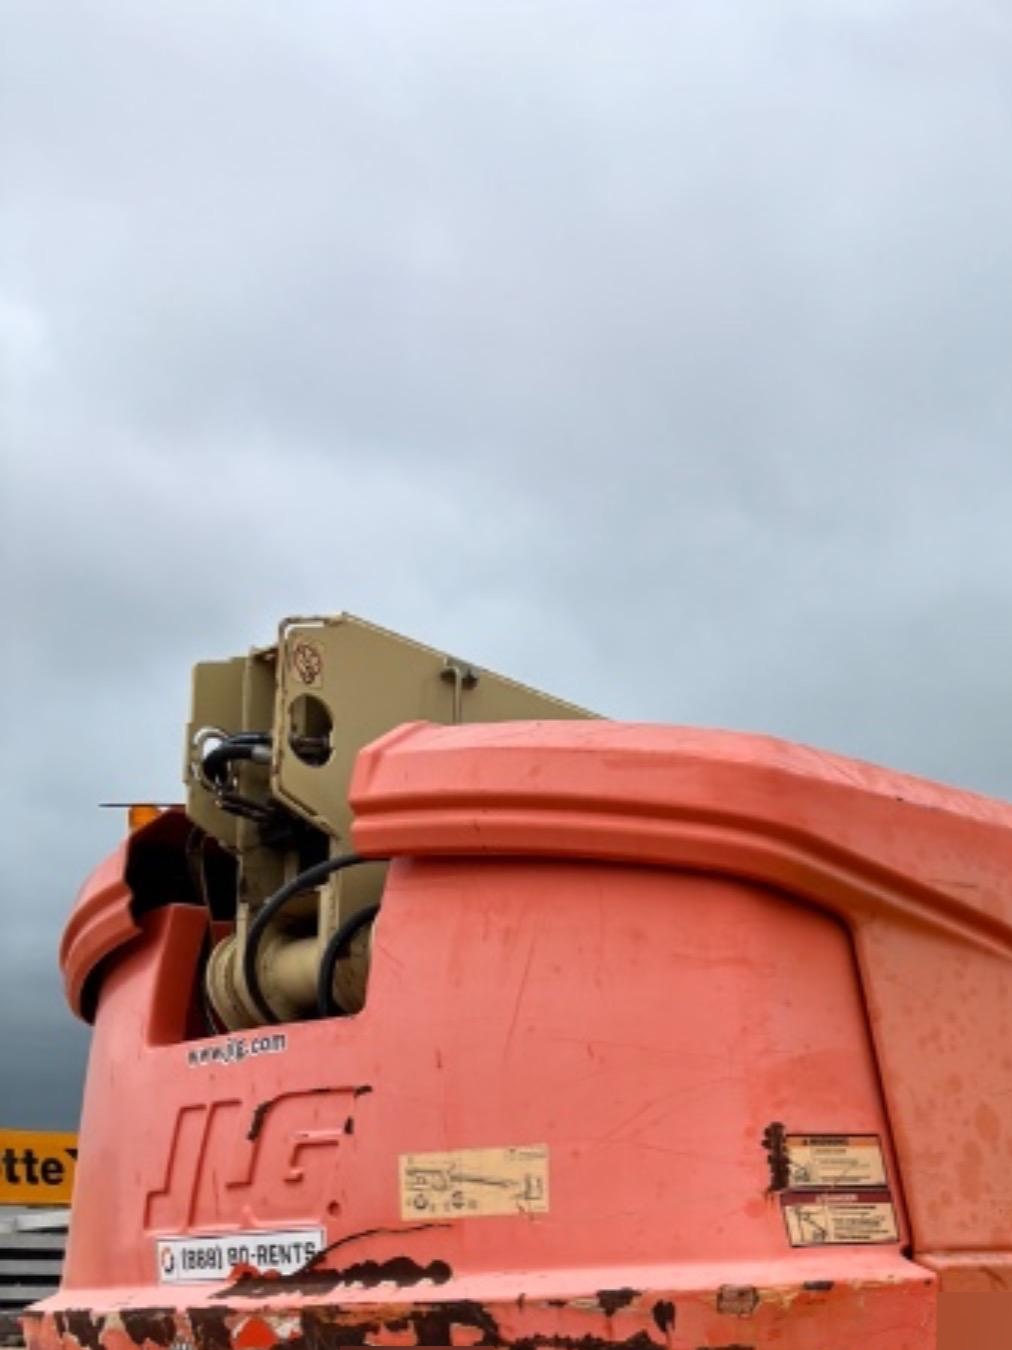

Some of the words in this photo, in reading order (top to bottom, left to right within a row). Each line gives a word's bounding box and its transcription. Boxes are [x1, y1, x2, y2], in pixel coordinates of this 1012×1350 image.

[187, 1033, 286, 1065] www.jlg.com
[0, 1147, 66, 1186] tte
[142, 1085, 373, 1234] JLG
